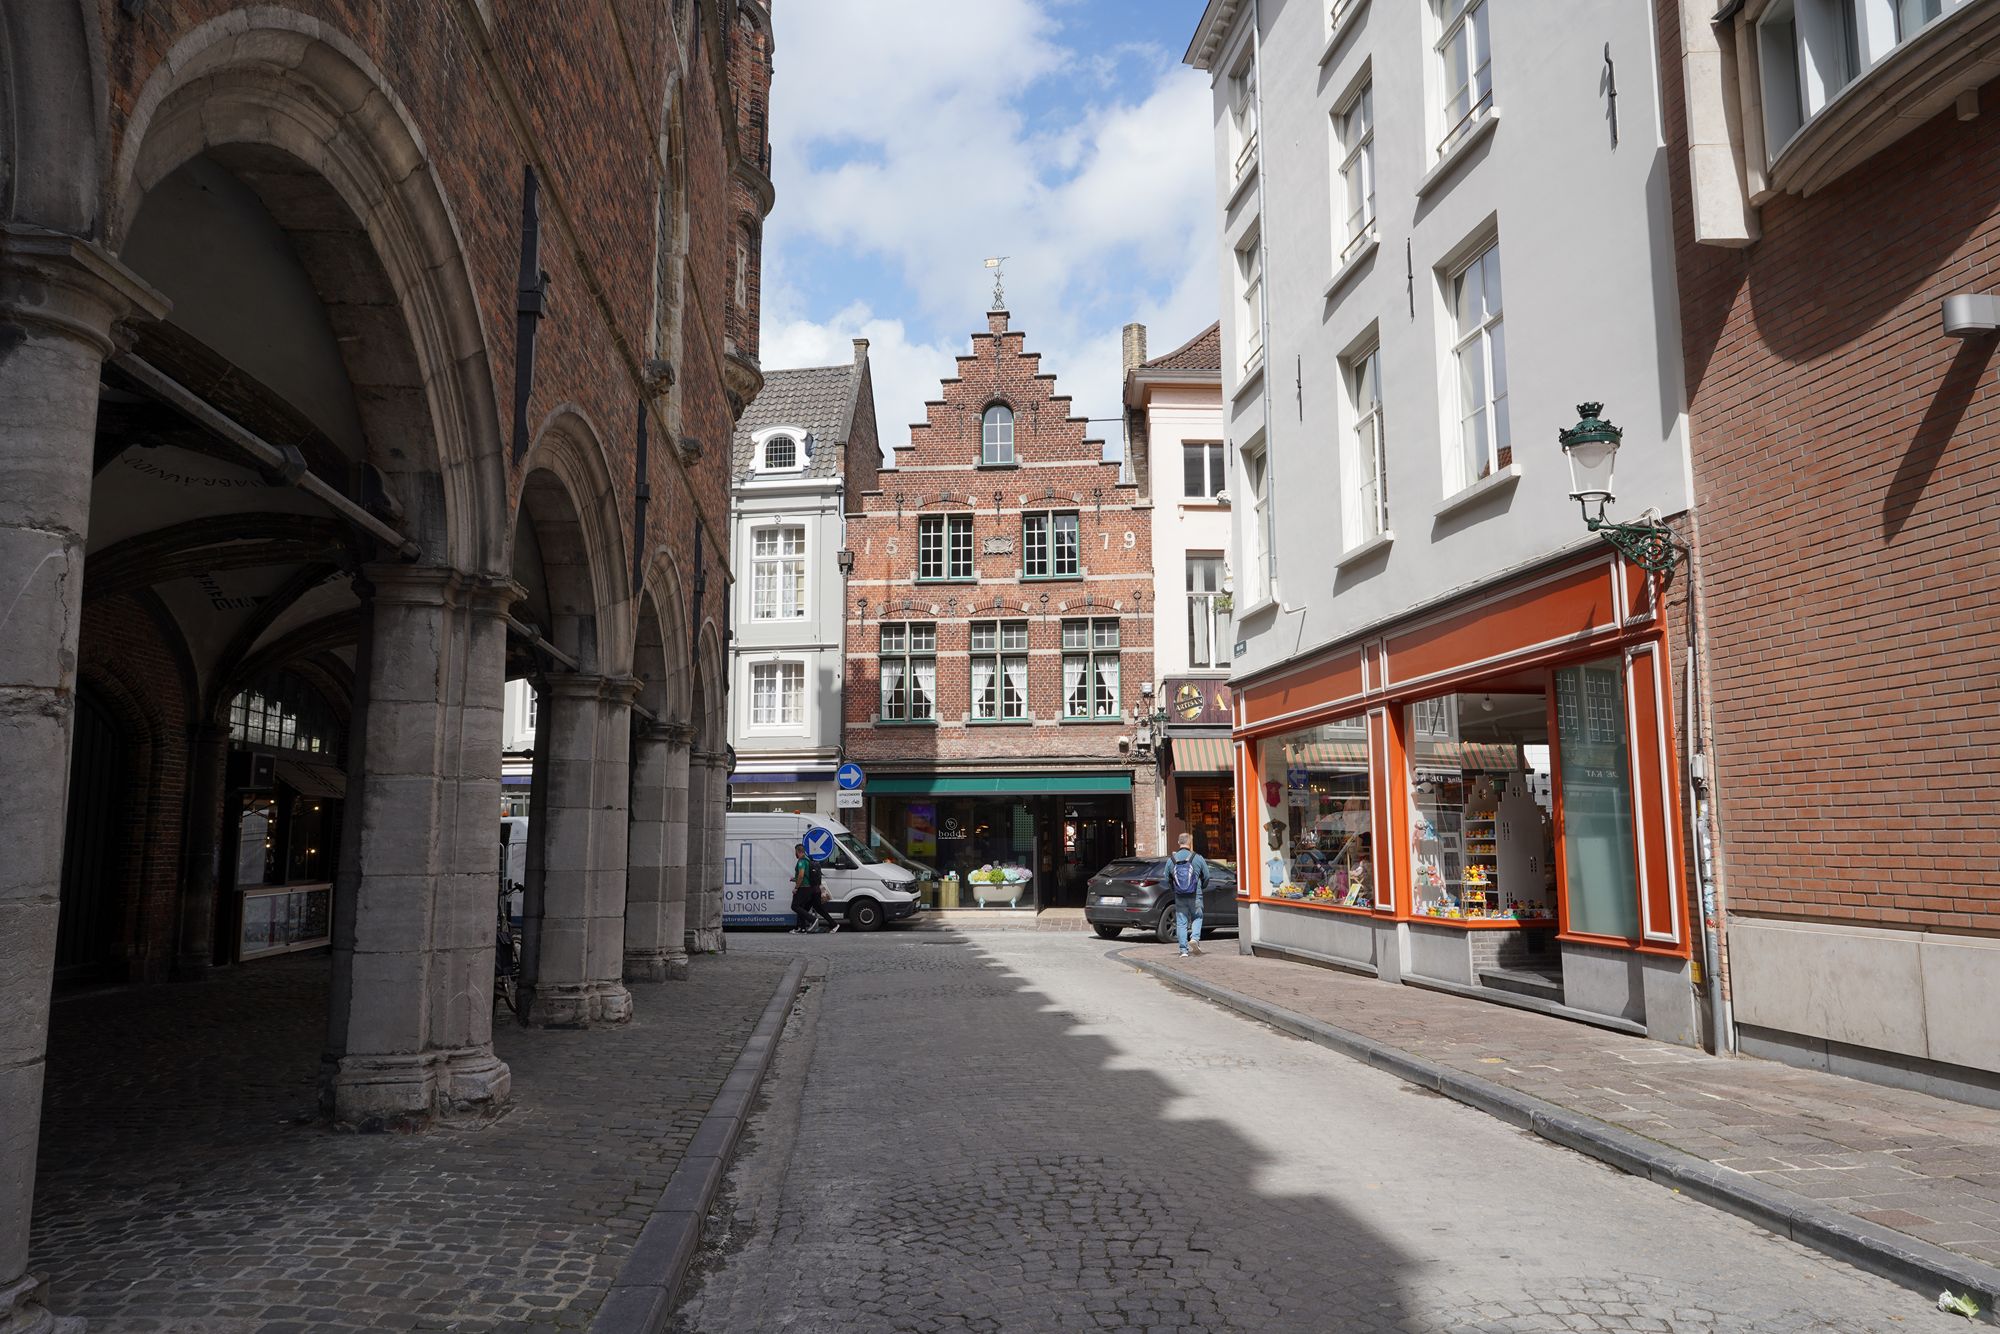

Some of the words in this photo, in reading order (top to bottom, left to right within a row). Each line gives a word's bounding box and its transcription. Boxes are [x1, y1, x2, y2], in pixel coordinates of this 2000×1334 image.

[1175, 698, 1203, 711] ARTISAN
[1209, 692, 1231, 711] A
[737, 891, 775, 900] STORE
[724, 903, 767, 912] LUTIONS
